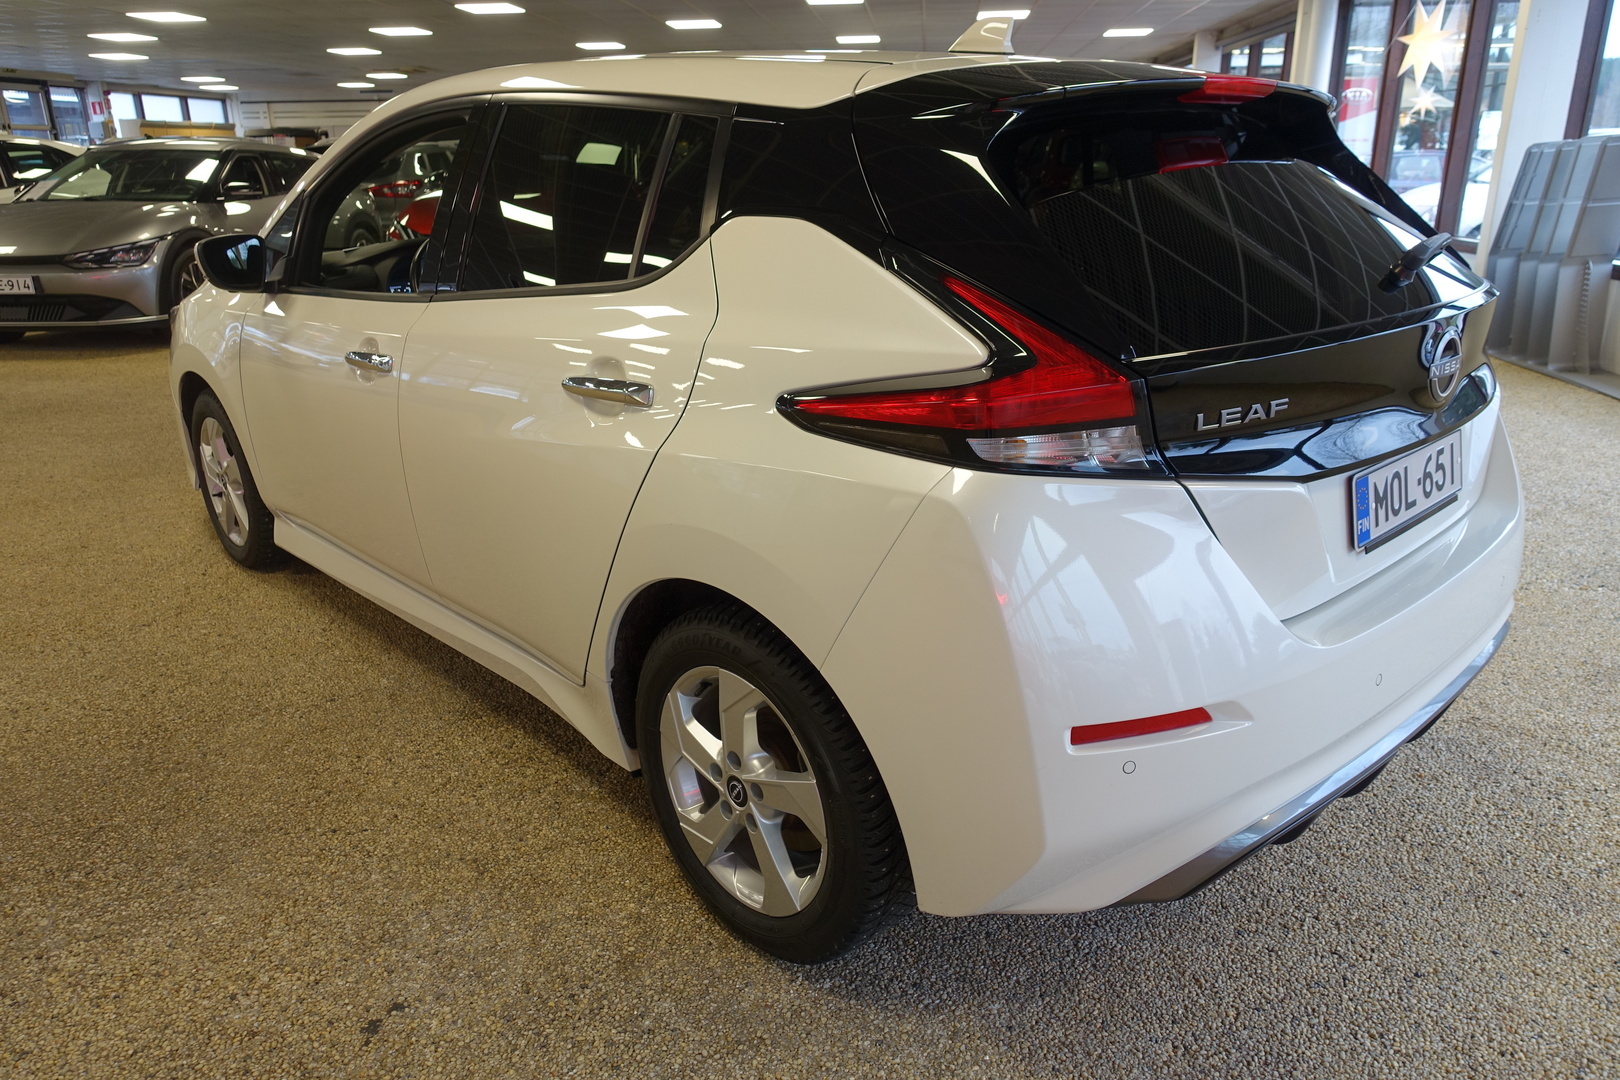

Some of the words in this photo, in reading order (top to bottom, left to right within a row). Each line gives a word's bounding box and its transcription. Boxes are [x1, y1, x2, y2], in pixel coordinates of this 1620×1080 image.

[1196, 398, 1289, 431] LEAF
[1374, 441, 1454, 528] MOL-651
[1358, 516, 1370, 535] FIN
